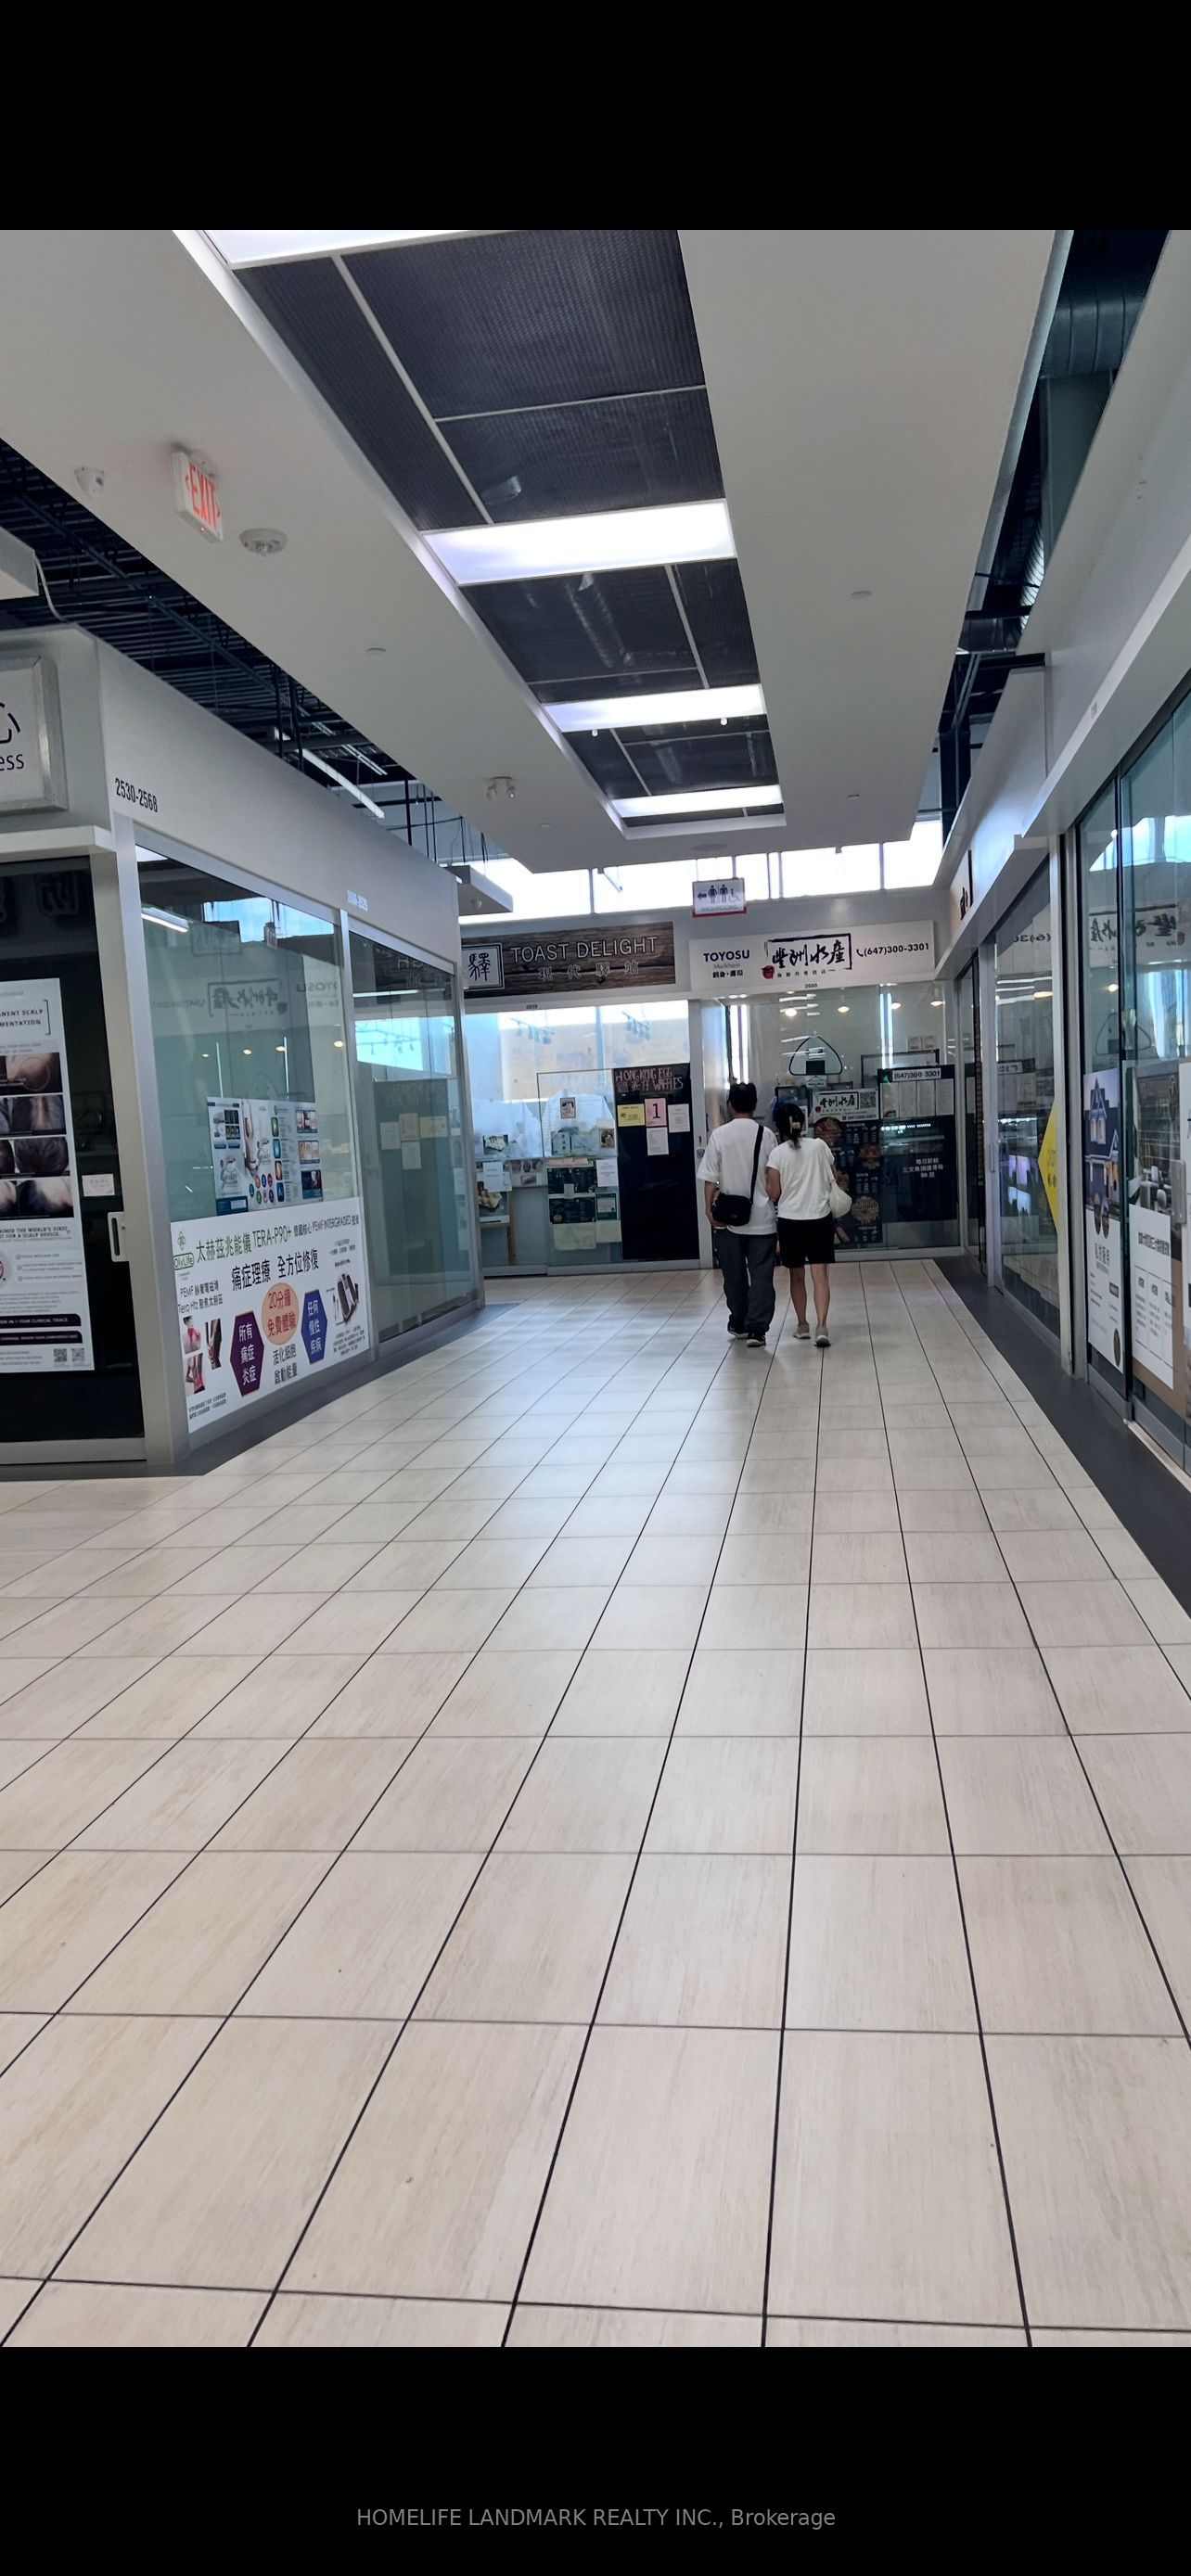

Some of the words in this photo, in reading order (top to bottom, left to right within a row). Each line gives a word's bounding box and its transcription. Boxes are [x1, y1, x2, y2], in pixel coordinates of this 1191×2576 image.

[188, 464, 219, 530] EXIT
[115, 777, 159, 812] 2530-2568
[511, 943, 570, 963] TOAST
[577, 936, 659, 959] DELIGHT
[703, 950, 750, 963] TOYOSU
[864, 942, 929, 957] (647)300-3301
[22, 1008, 43, 1016] SCALP
[659, 1066, 672, 1078] EGG
[652, 1103, 661, 1119] 1
[252, 1225, 292, 1248] TERA-P90+
[238, 1322, 253, 1342] 所有
